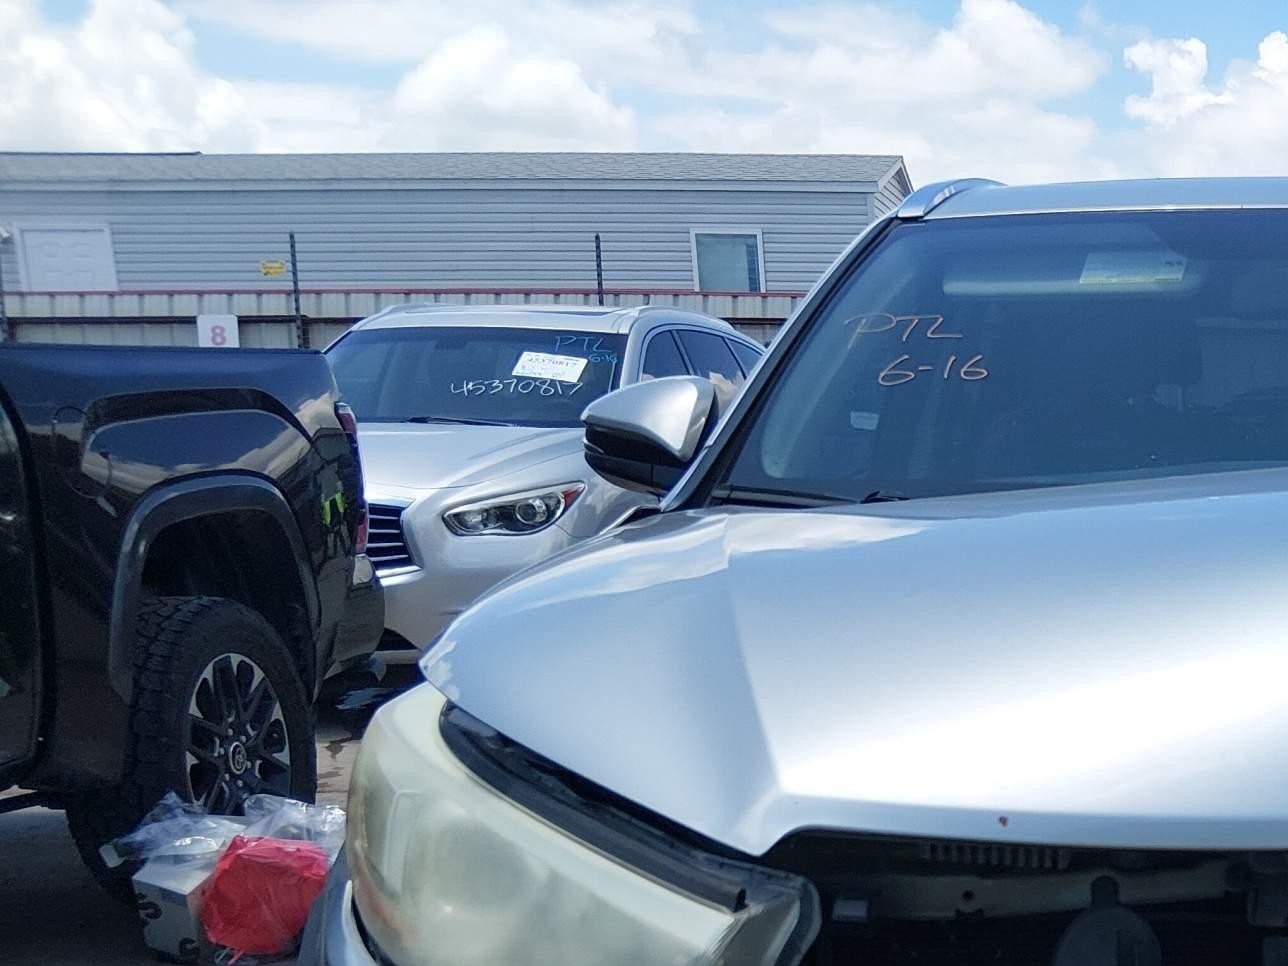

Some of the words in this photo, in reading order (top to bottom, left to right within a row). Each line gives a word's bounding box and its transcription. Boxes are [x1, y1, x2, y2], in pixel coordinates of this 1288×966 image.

[211, 325, 227, 346] 8
[878, 354, 988, 386] 6-16
[450, 379, 584, 397] 45370817
